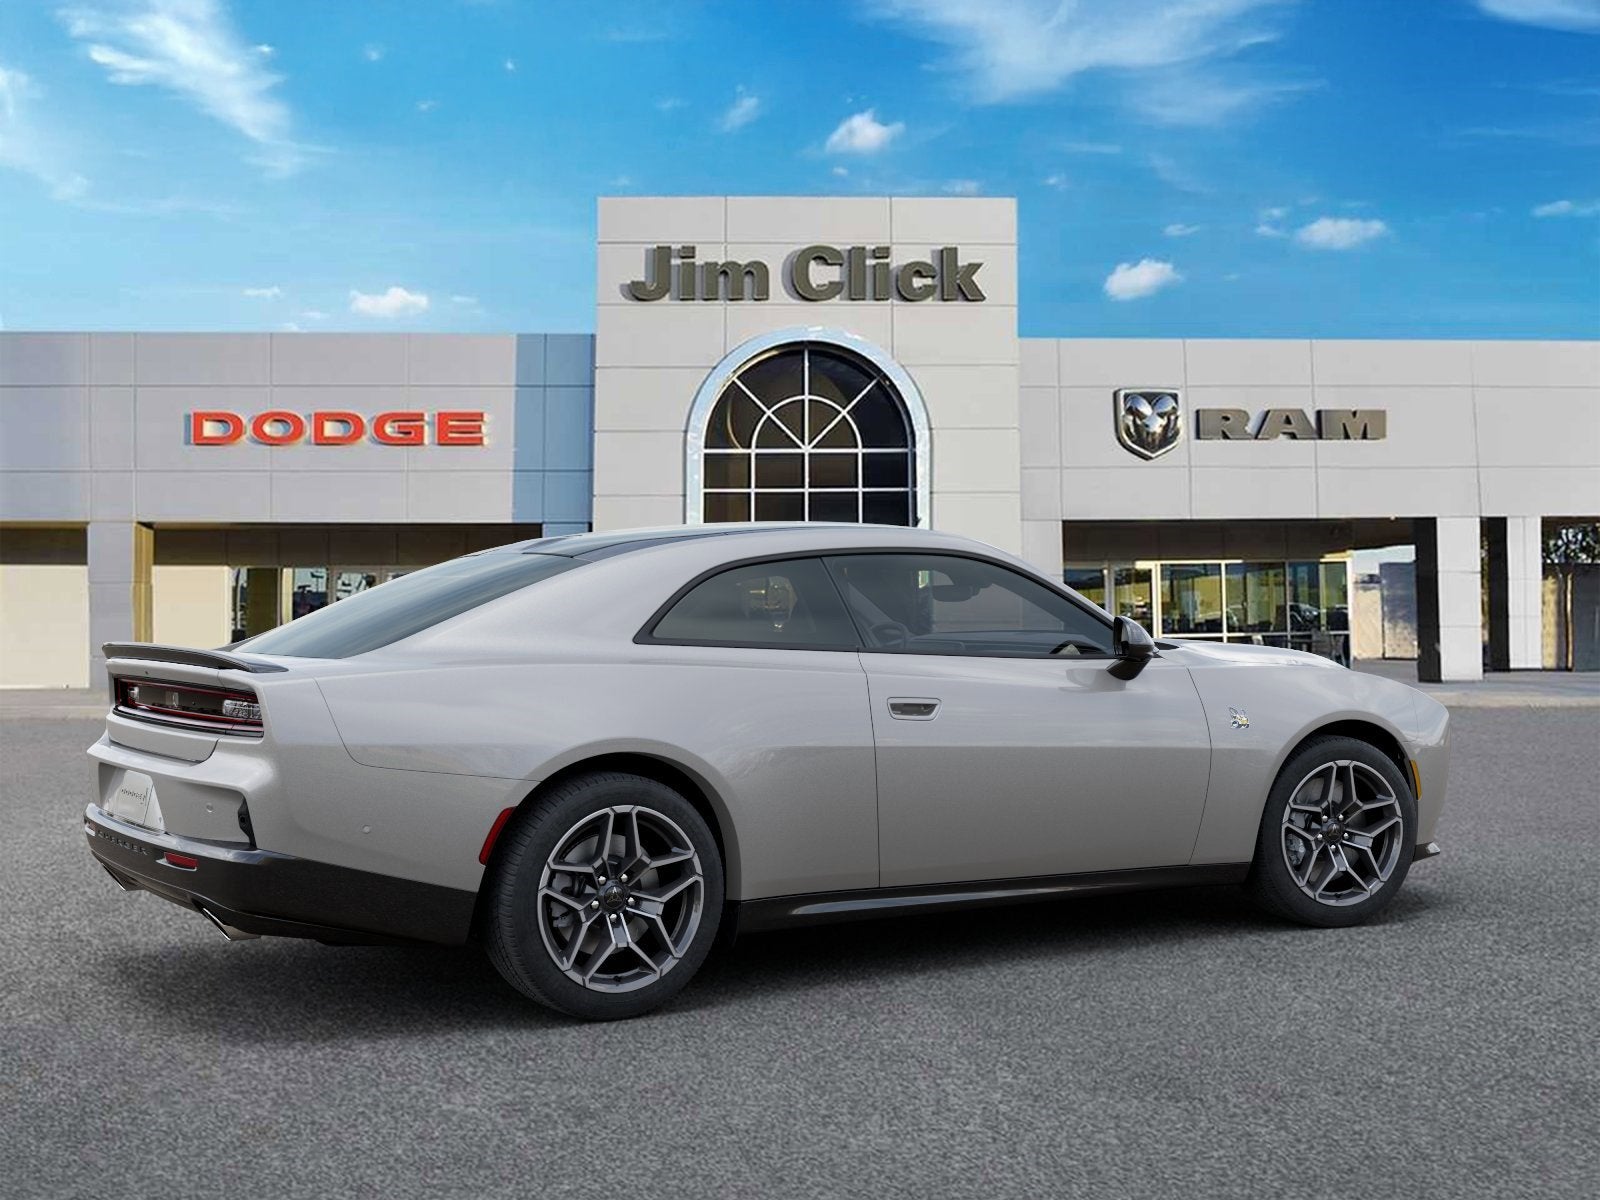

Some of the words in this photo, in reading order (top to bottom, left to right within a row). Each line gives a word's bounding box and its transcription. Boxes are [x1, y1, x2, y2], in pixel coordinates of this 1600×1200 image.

[628, 244, 770, 301] Jim
[791, 244, 986, 301] Click
[191, 410, 485, 446] DODGE
[1195, 408, 1387, 441] RAM
